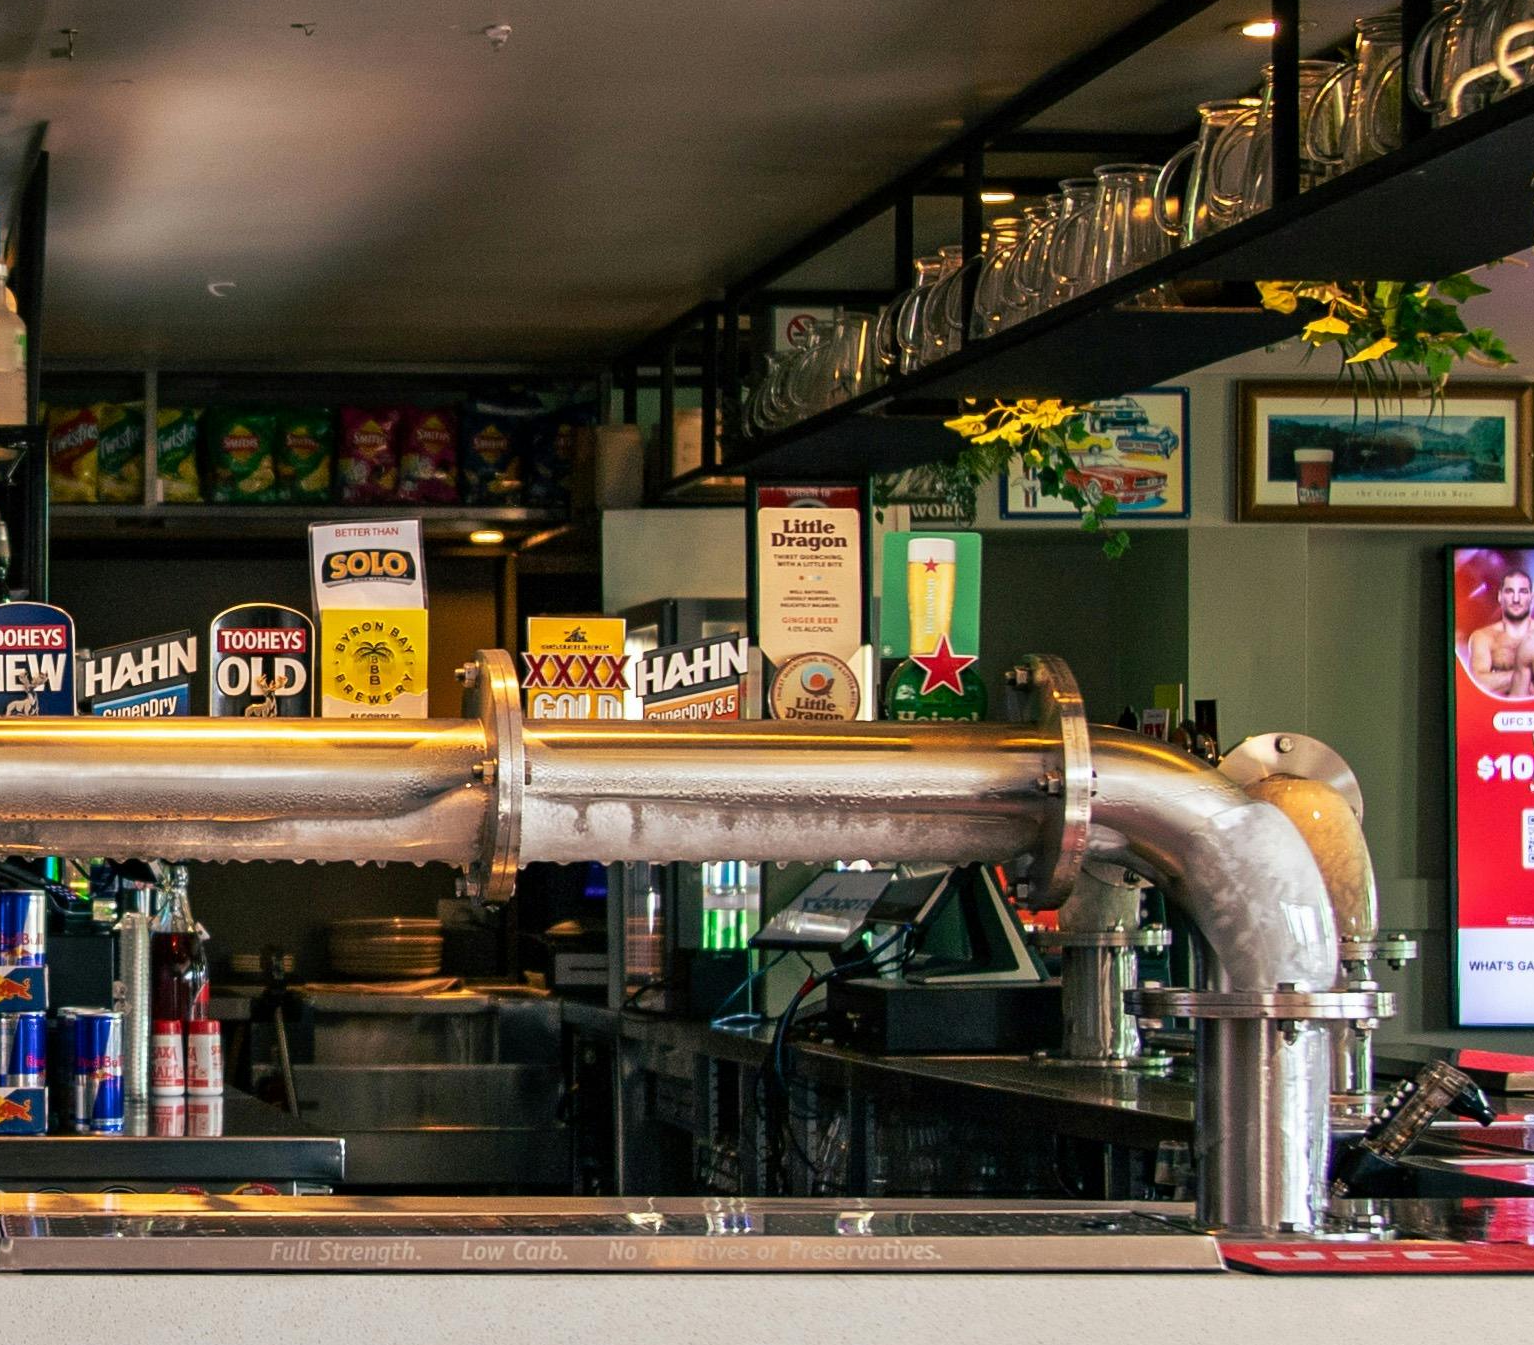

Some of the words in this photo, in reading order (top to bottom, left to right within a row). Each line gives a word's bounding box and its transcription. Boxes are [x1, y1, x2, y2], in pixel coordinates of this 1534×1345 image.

[334, 527, 370, 538] BETTER
[372, 527, 399, 536] THAN
[782, 520, 836, 534] Little
[771, 533, 848, 551] Dragon
[329, 551, 408, 579] SOLO
[221, 627, 304, 651] TOOHEYS
[335, 622, 385, 653] BYRON
[389, 626, 415, 654] BAY
[85, 636, 198, 698] HAHN
[217, 656, 306, 698] OLD
[521, 652, 632, 691] XXXX
[635, 637, 749, 698] HAHN
[334, 673, 413, 704] BREWERY
[533, 692, 623, 720] GOLD
[714, 695, 737, 715] 3.5
[795, 697, 836, 712] Little
[1501, 717, 1524, 726] UFC
[1469, 960, 1515, 972] WHAT'S
[270, 1240, 310, 1262] Full
[318, 1240, 422, 1267] Strength.
[462, 1240, 505, 1262] Low
[512, 1240, 569, 1262] Carb.
[608, 1241, 637, 1261] No
[646, 1239, 749, 1262] Aditives
[756, 1245, 779, 1261] or
[788, 1238, 942, 1262] Preservatives.
[1251, 1250, 1473, 1261] UFC
